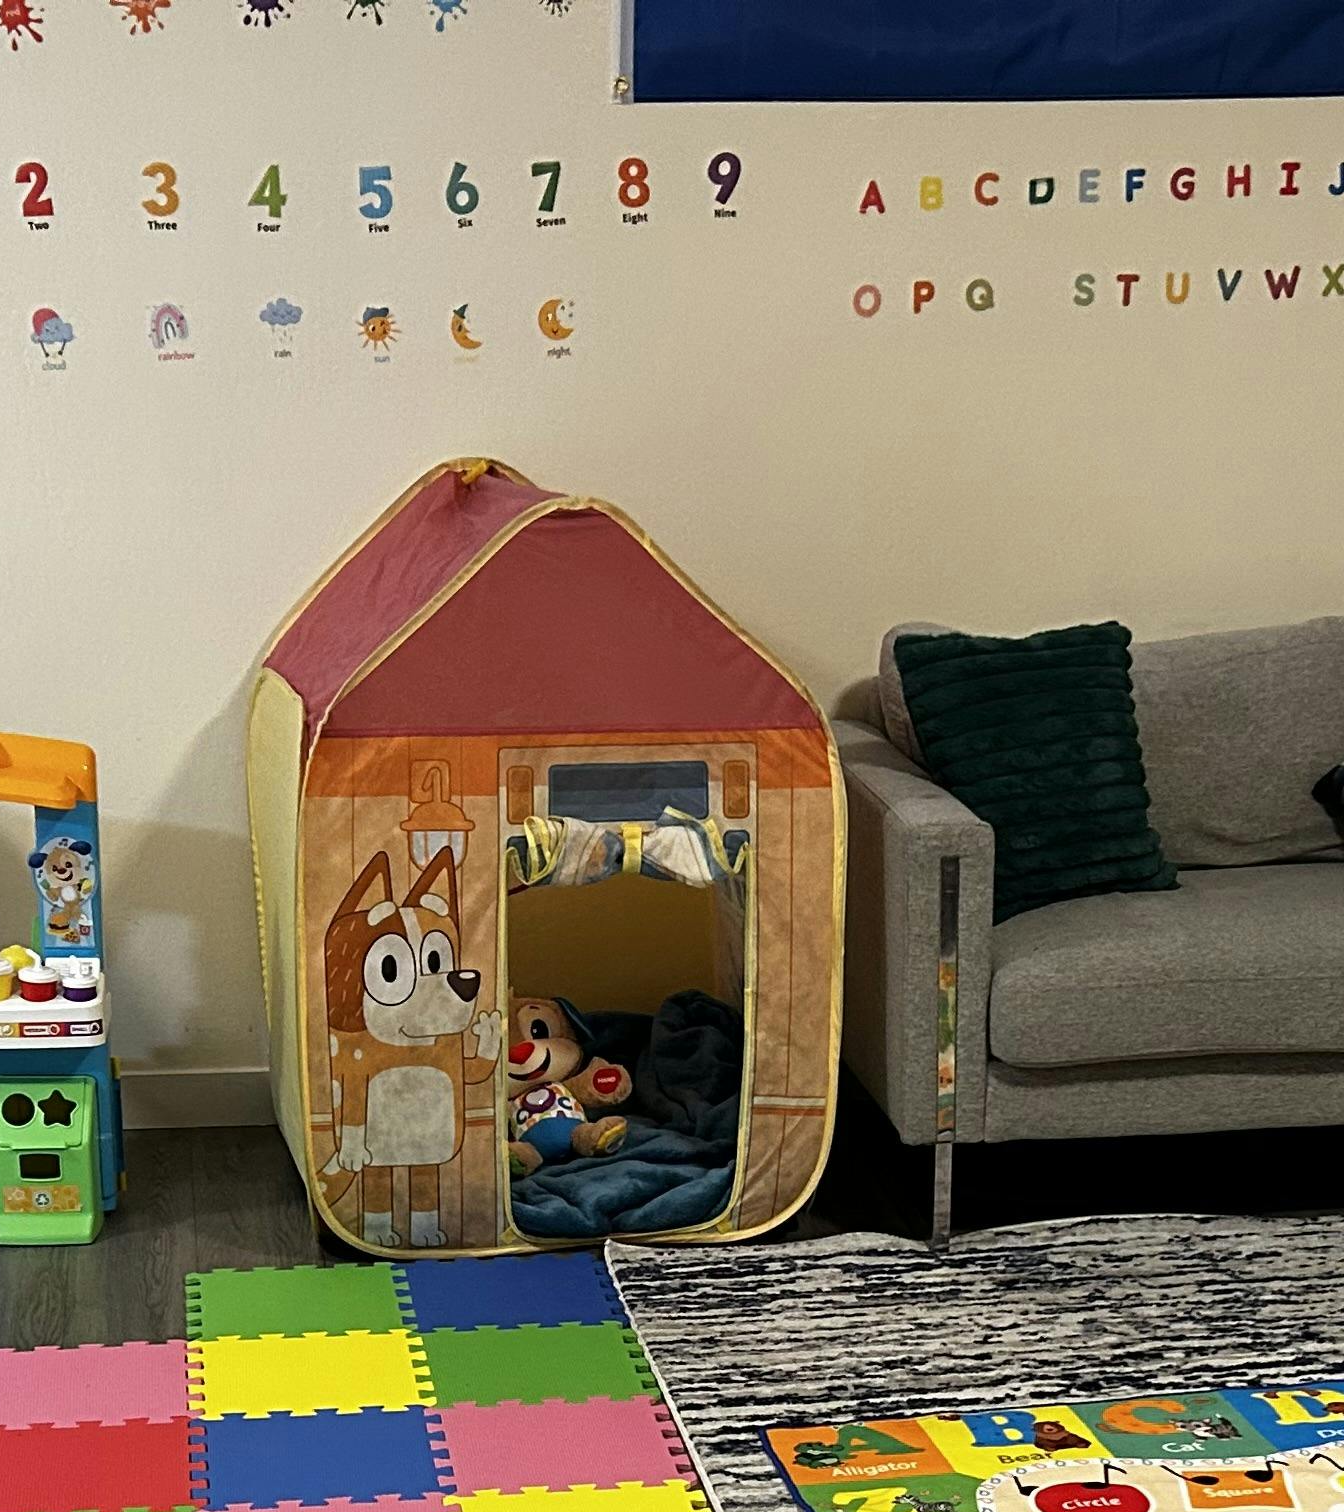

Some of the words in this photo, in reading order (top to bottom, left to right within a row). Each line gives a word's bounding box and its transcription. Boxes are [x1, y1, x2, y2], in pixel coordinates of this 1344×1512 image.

[15, 161, 54, 217] 2
[142, 161, 179, 216] 3
[248, 164, 288, 218] 4
[359, 166, 393, 219] 5
[446, 161, 479, 215] 6
[531, 161, 561, 212] 7
[618, 157, 650, 208] 8
[708, 152, 741, 205] 9
[859, 179, 886, 215] A
[919, 175, 944, 212] B
[974, 172, 1000, 206] C
[1029, 177, 1055, 206] D
[1078, 168, 1101, 204] E
[1125, 168, 1146, 203] F
[1170, 167, 1196, 201] G
[1226, 164, 1251, 198] H
[1279, 162, 1301, 195] I
[27, 221, 50, 230] Two
[147, 220, 178, 231] Three
[257, 223, 281, 233] Four
[369, 224, 390, 233] Five
[458, 218, 474, 228] Six
[536, 216, 566, 228] Seven
[622, 212, 649, 226] Eight
[714, 209, 737, 218] Nine
[852, 284, 882, 318] O
[913, 280, 935, 314] P
[965, 278, 995, 312] Q
[1073, 273, 1096, 306] S
[1116, 273, 1141, 306] T
[1165, 272, 1190, 305] U
[1217, 268, 1243, 301] V
[1264, 265, 1301, 300] W
[42, 361, 66, 371] cloud
[158, 350, 195, 361] rainbow
[274, 349, 292, 358] rain
[374, 355, 391, 363] sun
[547, 346, 572, 359] night
[959, 1411, 1037, 1448] B
[1098, 1400, 1186, 1435] C
[838, 1424, 926, 1459] A
[1162, 1441, 1207, 1453] Cat
[831, 1460, 919, 1478] Alligator
[997, 1450, 1054, 1465] Bear
[1061, 1495, 1122, 1511] Circle
[1205, 1484, 1274, 1499] Square
